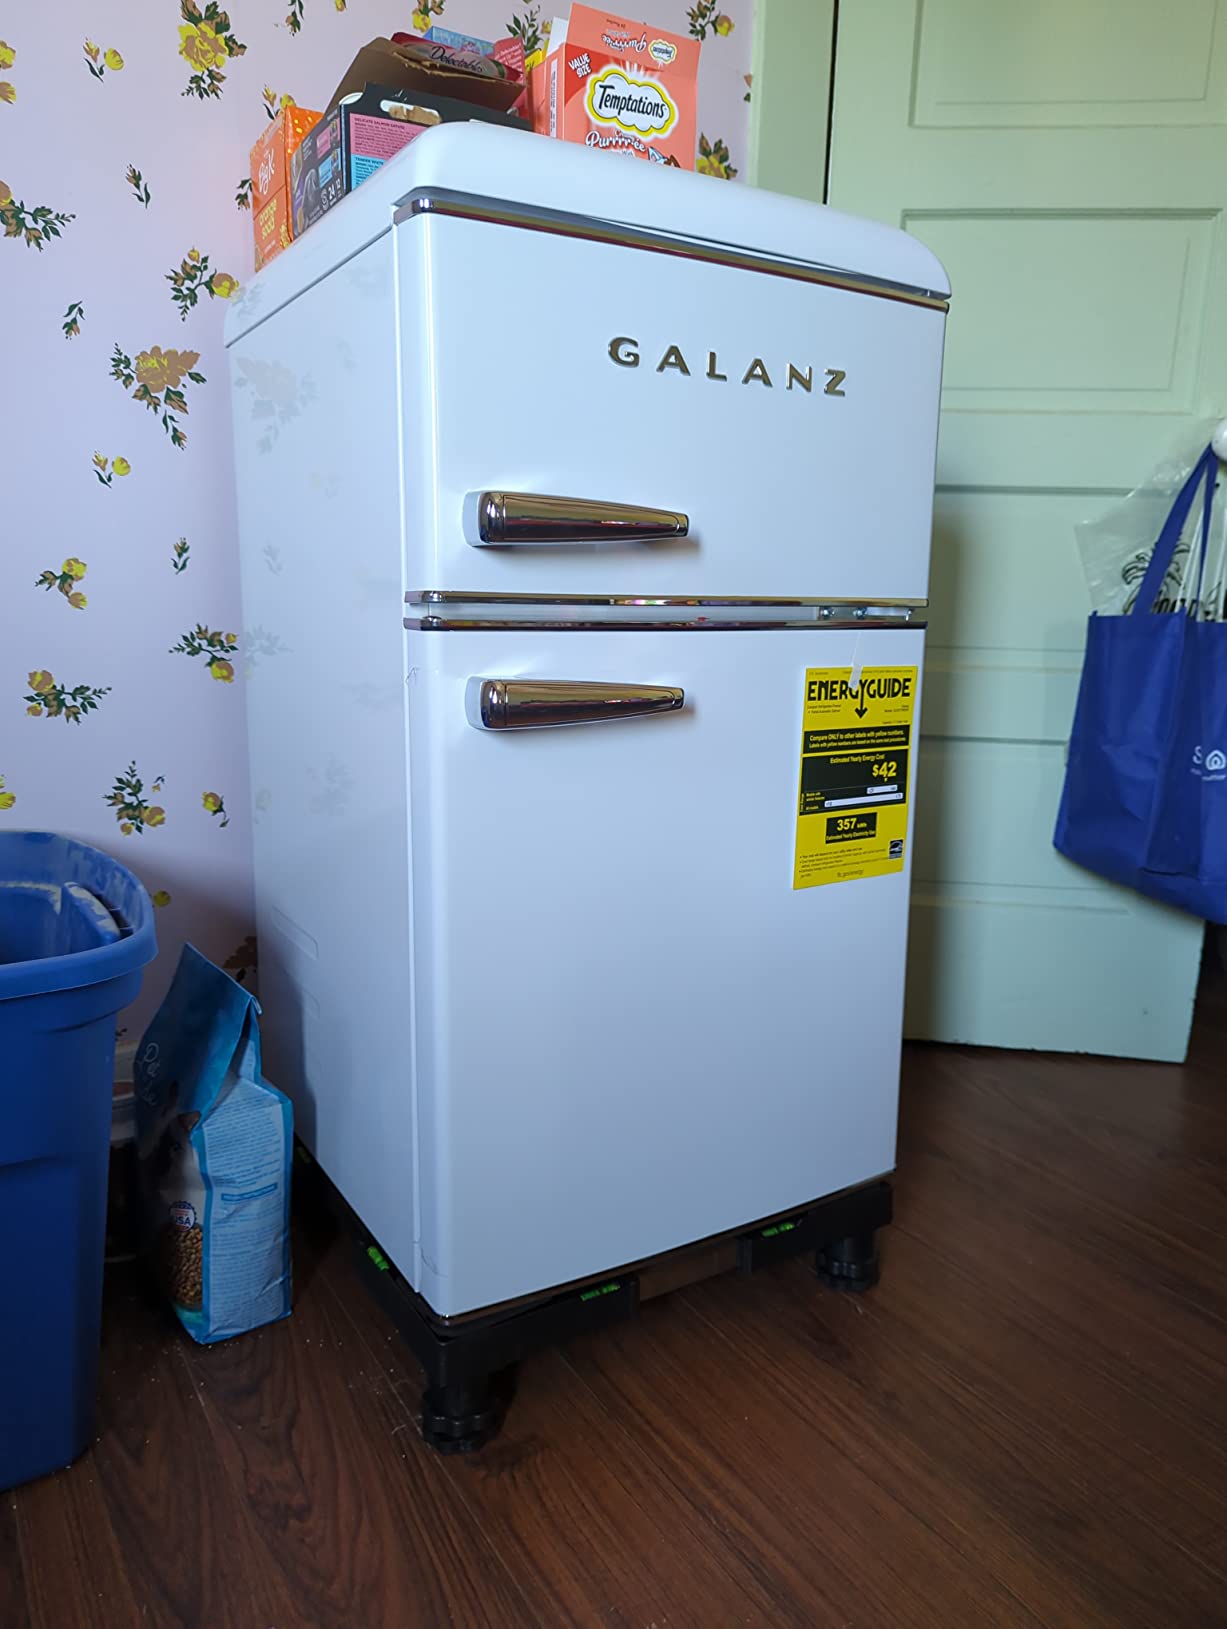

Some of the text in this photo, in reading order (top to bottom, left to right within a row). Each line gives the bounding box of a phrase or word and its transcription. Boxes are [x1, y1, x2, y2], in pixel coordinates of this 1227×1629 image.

[568, 53, 592, 71] VALUE
[576, 64, 592, 78] SIZE
[598, 84, 666, 118] Temptations
[608, 336, 846, 397] GALANZ
[872, 761, 897, 778] $42
[837, 818, 857, 831] 357
